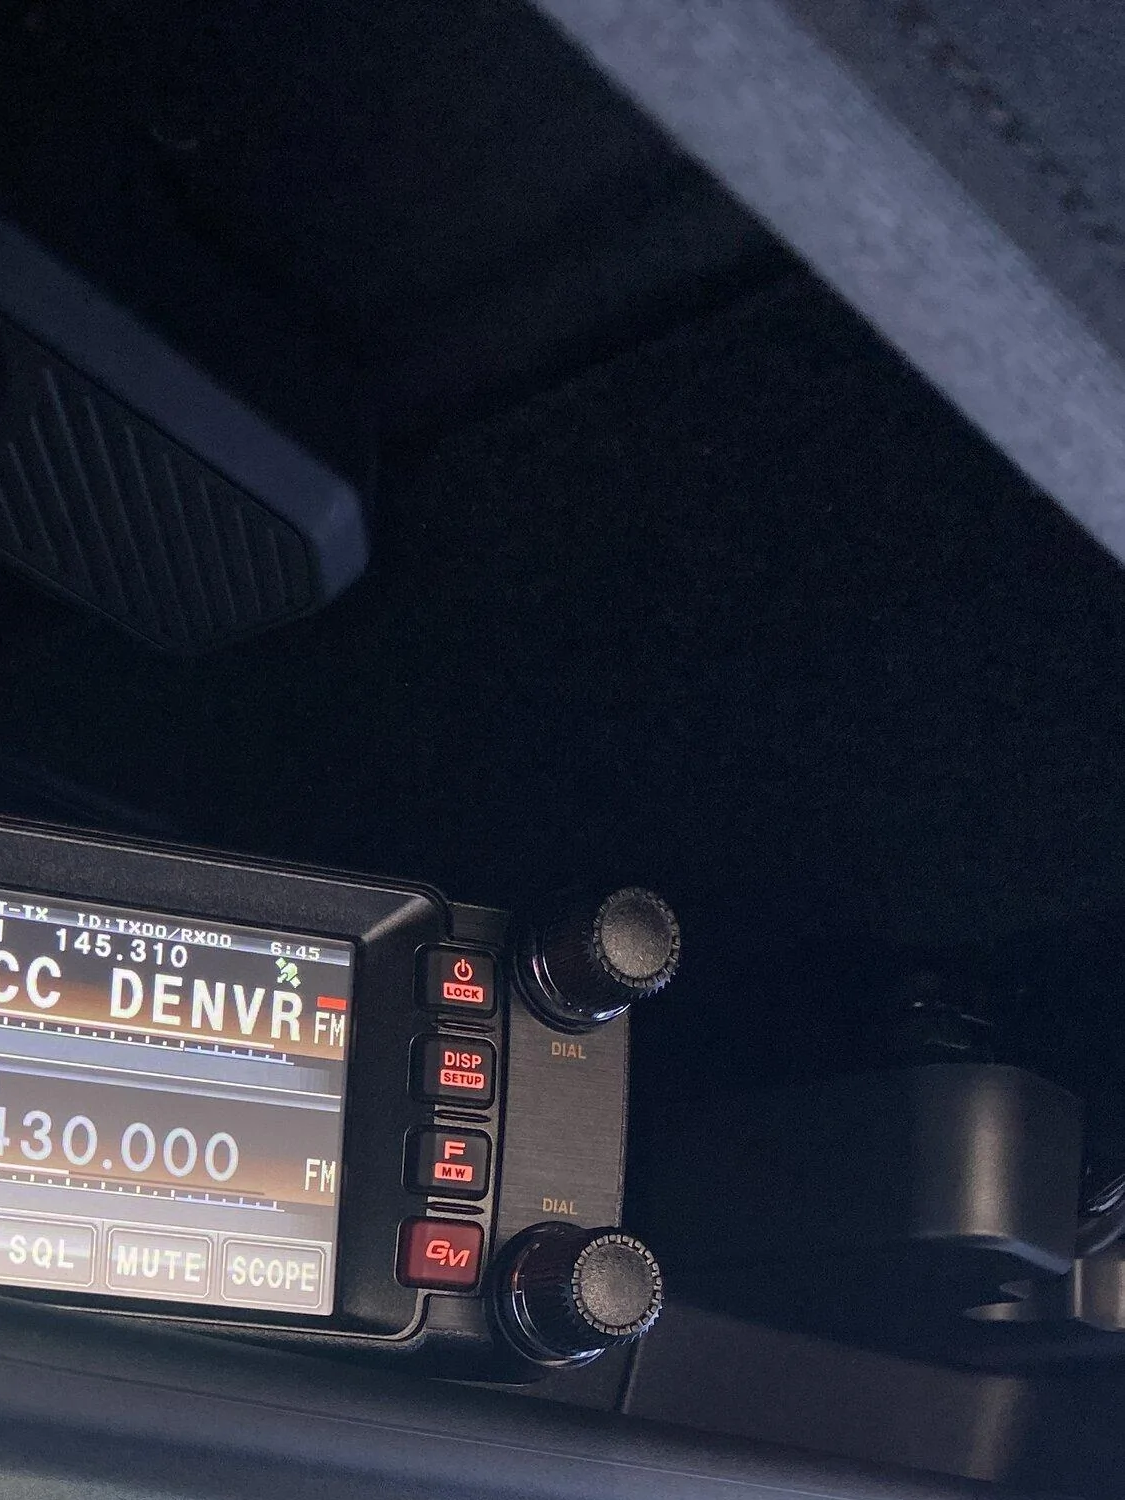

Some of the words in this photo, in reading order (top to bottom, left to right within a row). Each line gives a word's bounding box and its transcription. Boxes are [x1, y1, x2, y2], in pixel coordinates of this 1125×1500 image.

[56, 928, 188, 968] 145.310
[270, 941, 322, 961] 6:45
[109, 966, 304, 1042] DENVR
[446, 986, 480, 1001] LOCK
[314, 1012, 346, 1048] FM
[444, 1051, 482, 1069] DISP
[551, 1041, 587, 1060] DIAL
[443, 1072, 482, 1086] SETUP
[444, 1141, 466, 1159] F
[305, 1158, 337, 1194] FM
[542, 1197, 579, 1216] DIAL
[9, 1235, 75, 1270] SQL
[116, 1246, 202, 1283] MUTE
[232, 1257, 317, 1293] SCOPE
